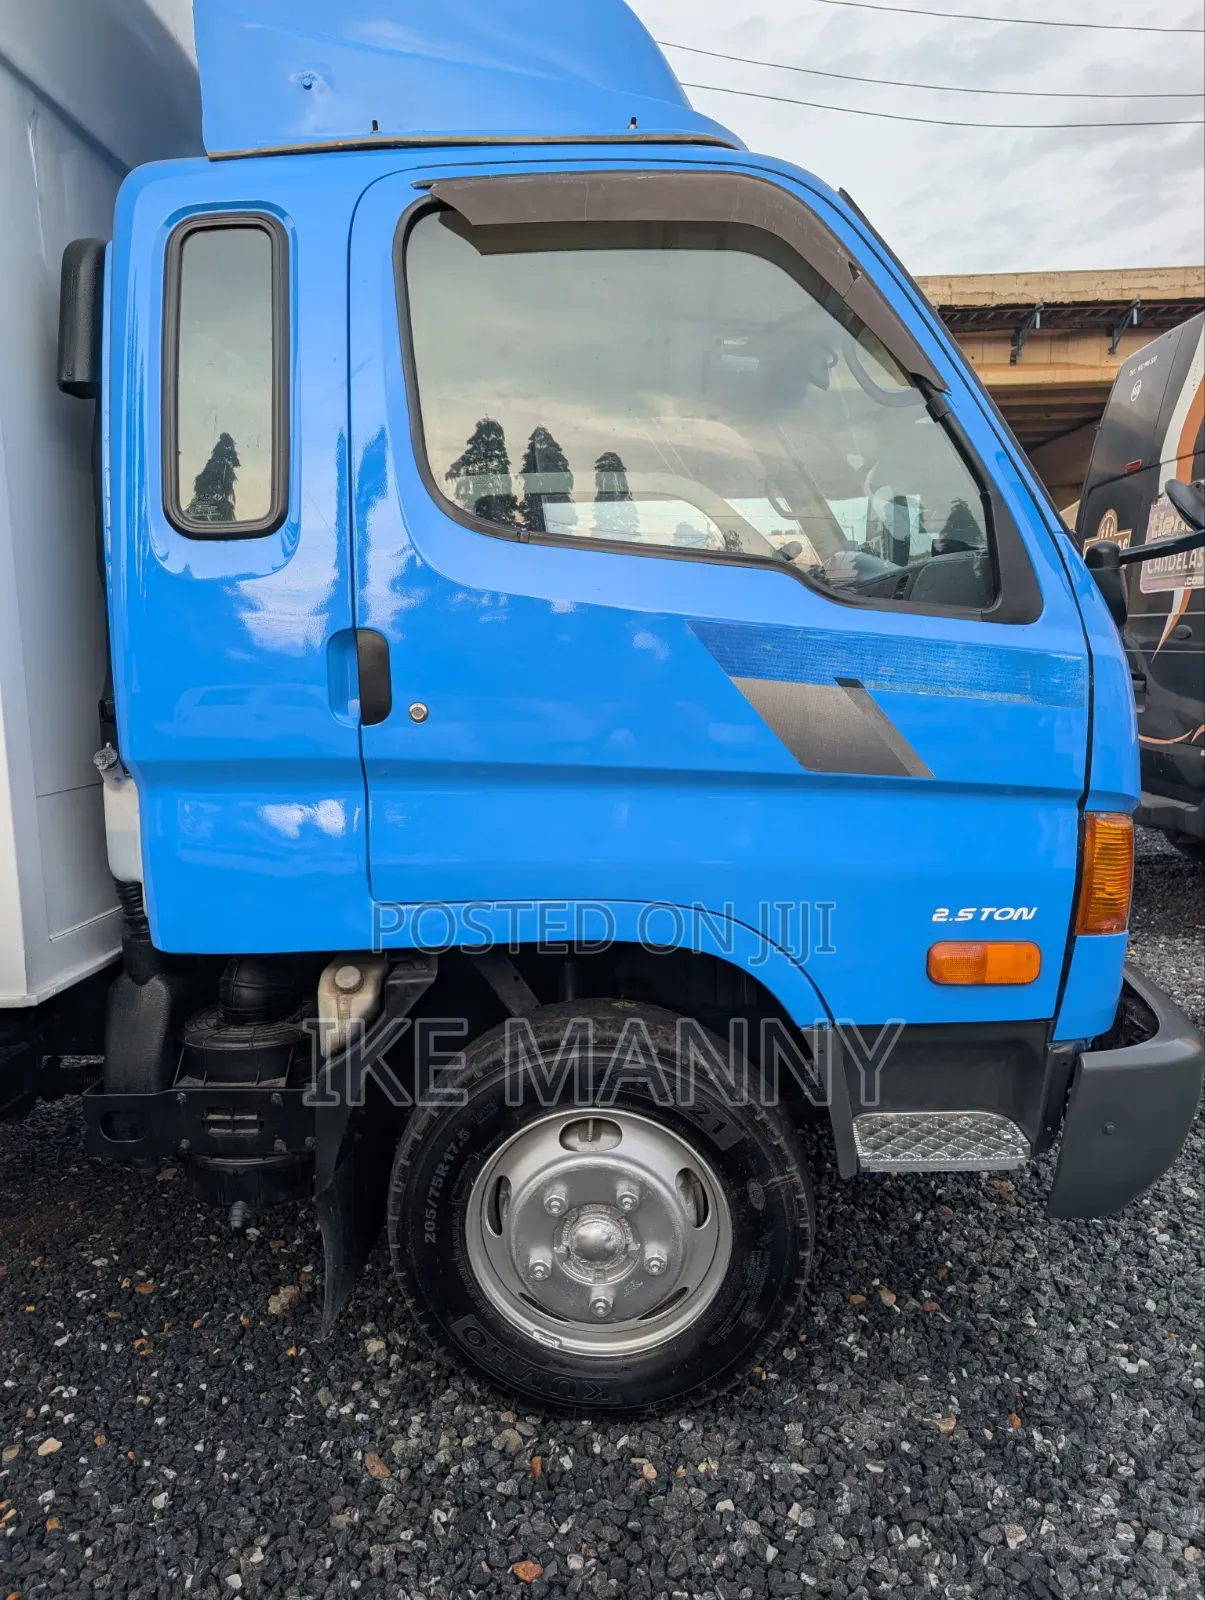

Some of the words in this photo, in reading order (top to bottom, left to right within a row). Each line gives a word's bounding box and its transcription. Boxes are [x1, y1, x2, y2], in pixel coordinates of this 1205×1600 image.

[932, 907, 977, 922] 2.5
[980, 906, 1038, 921] TON
[424, 1127, 471, 1244] 205/75R17.5
[462, 1326, 611, 1401] KUMHO
